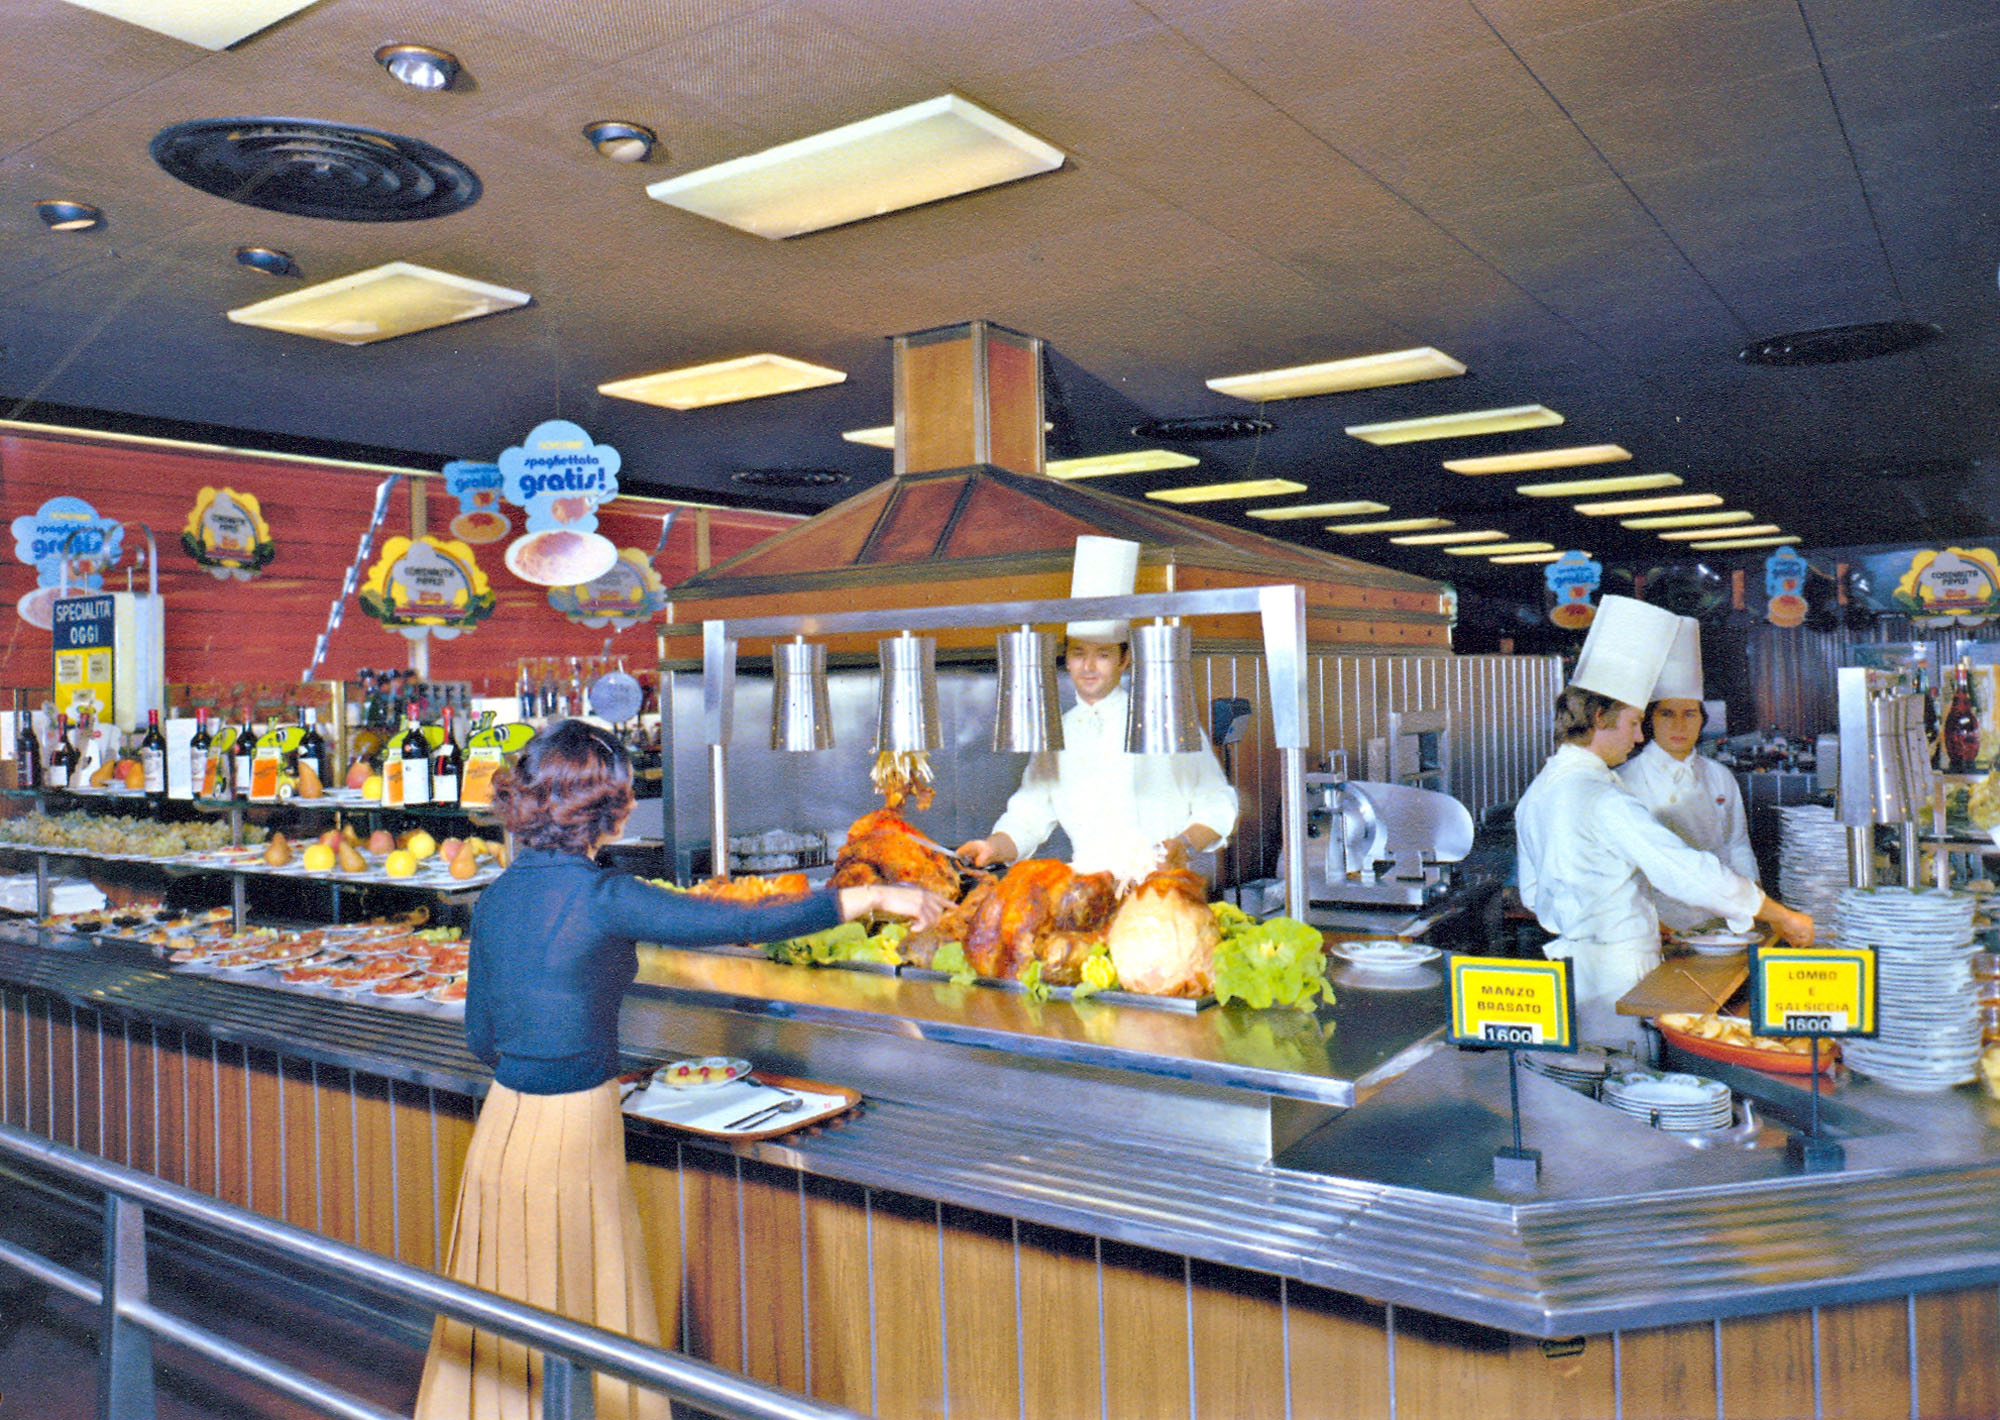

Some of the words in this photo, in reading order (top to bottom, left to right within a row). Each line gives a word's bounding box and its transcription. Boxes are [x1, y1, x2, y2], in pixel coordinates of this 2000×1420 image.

[524, 454, 600, 469] spaghettata
[519, 466, 606, 500] gratis!
[70, 624, 99, 644] OGGI
[1788, 970, 1838, 981] LOMBO
[1481, 985, 1535, 998] MANZO
[1808, 986, 1815, 997] E
[1477, 1000, 1541, 1015] BRASATO
[1775, 1002, 1849, 1013] SALSICCIA
[1787, 1016, 1832, 1031] 1600
[1486, 1026, 1532, 1043] 1600
